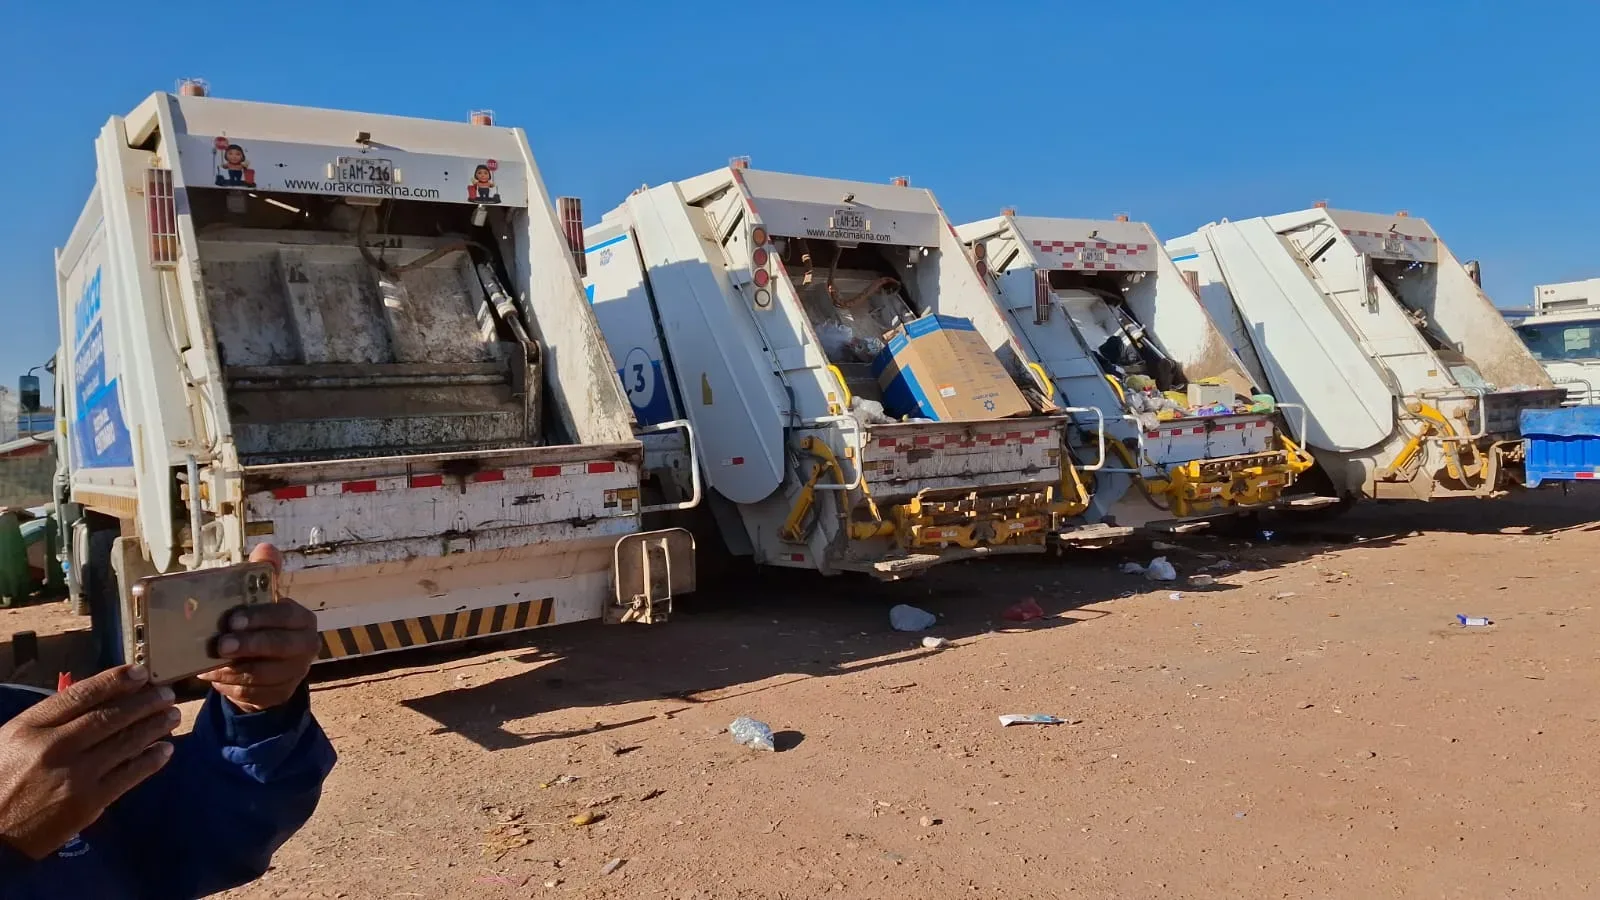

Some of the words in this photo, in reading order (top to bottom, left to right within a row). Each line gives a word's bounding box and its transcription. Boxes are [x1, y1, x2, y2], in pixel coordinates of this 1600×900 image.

[342, 164, 390, 181] EAM-216
[284, 177, 440, 199] www.orakcimakina.com
[806, 228, 891, 241] www.orakcimakina.com
[632, 363, 646, 393] 3
